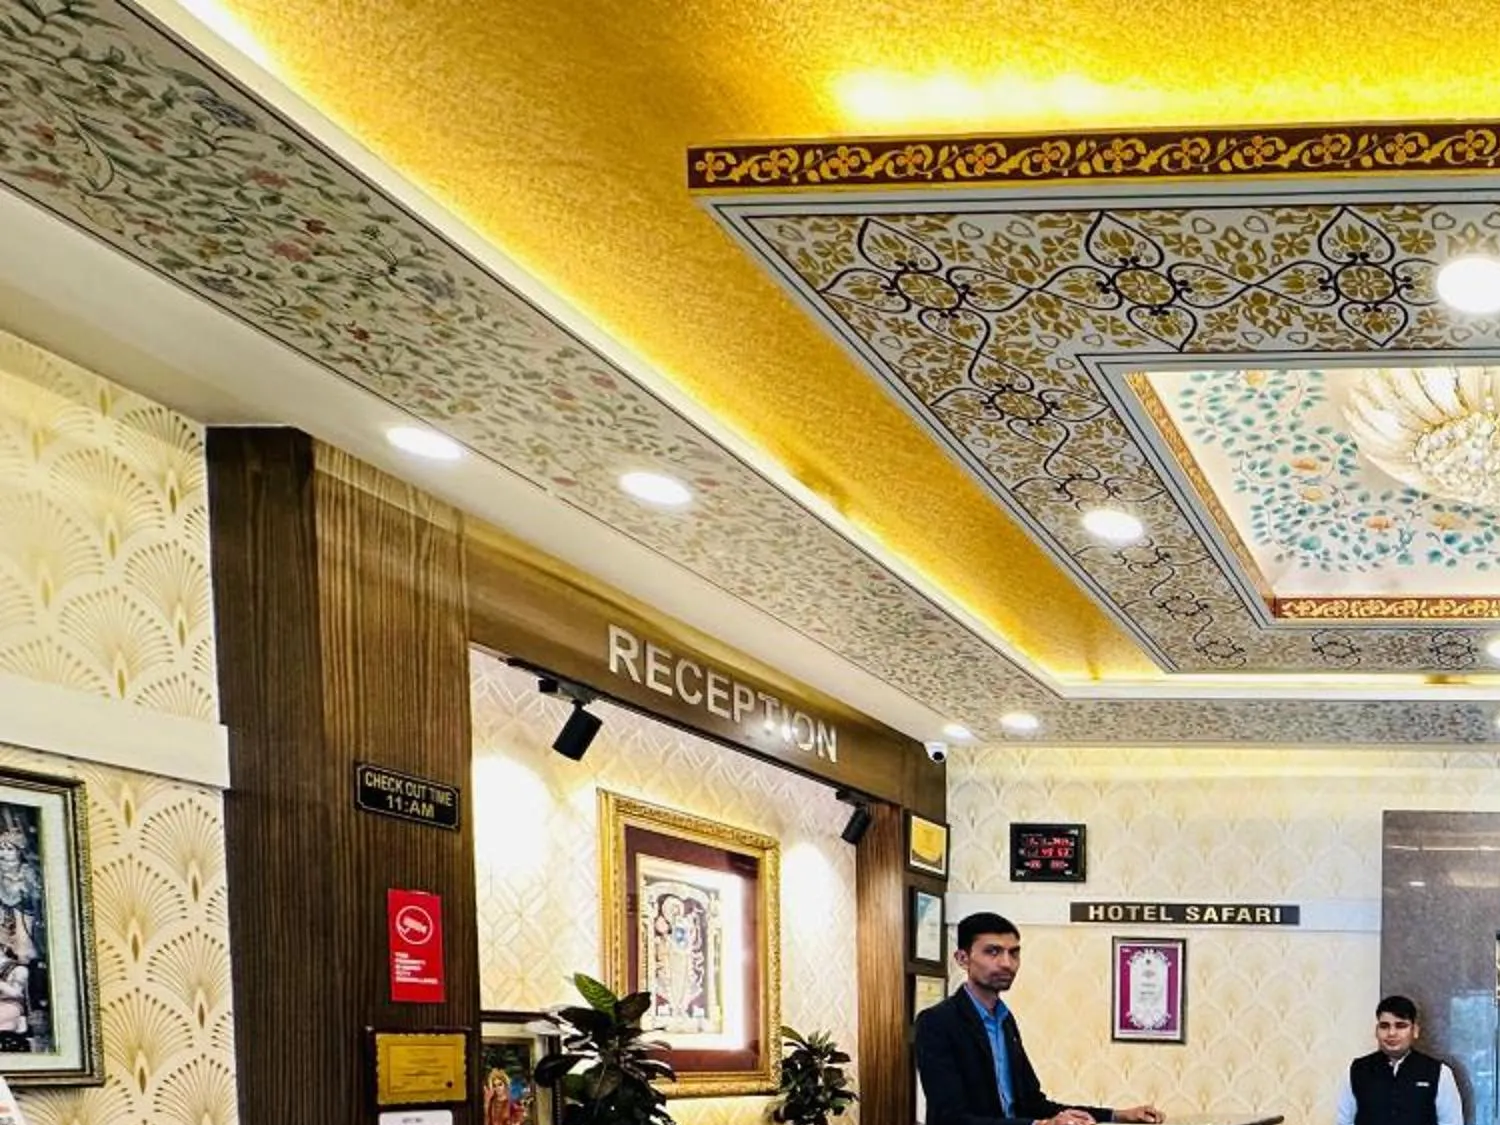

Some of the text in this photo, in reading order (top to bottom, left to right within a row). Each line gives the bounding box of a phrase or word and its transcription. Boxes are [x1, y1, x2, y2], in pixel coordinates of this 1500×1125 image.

[608, 624, 837, 763] RECEPTION
[365, 771, 453, 807] CHECK OUT TIME
[386, 794, 435, 818] 11:AM
[1088, 905, 1281, 923] HOTEL SAFARI
